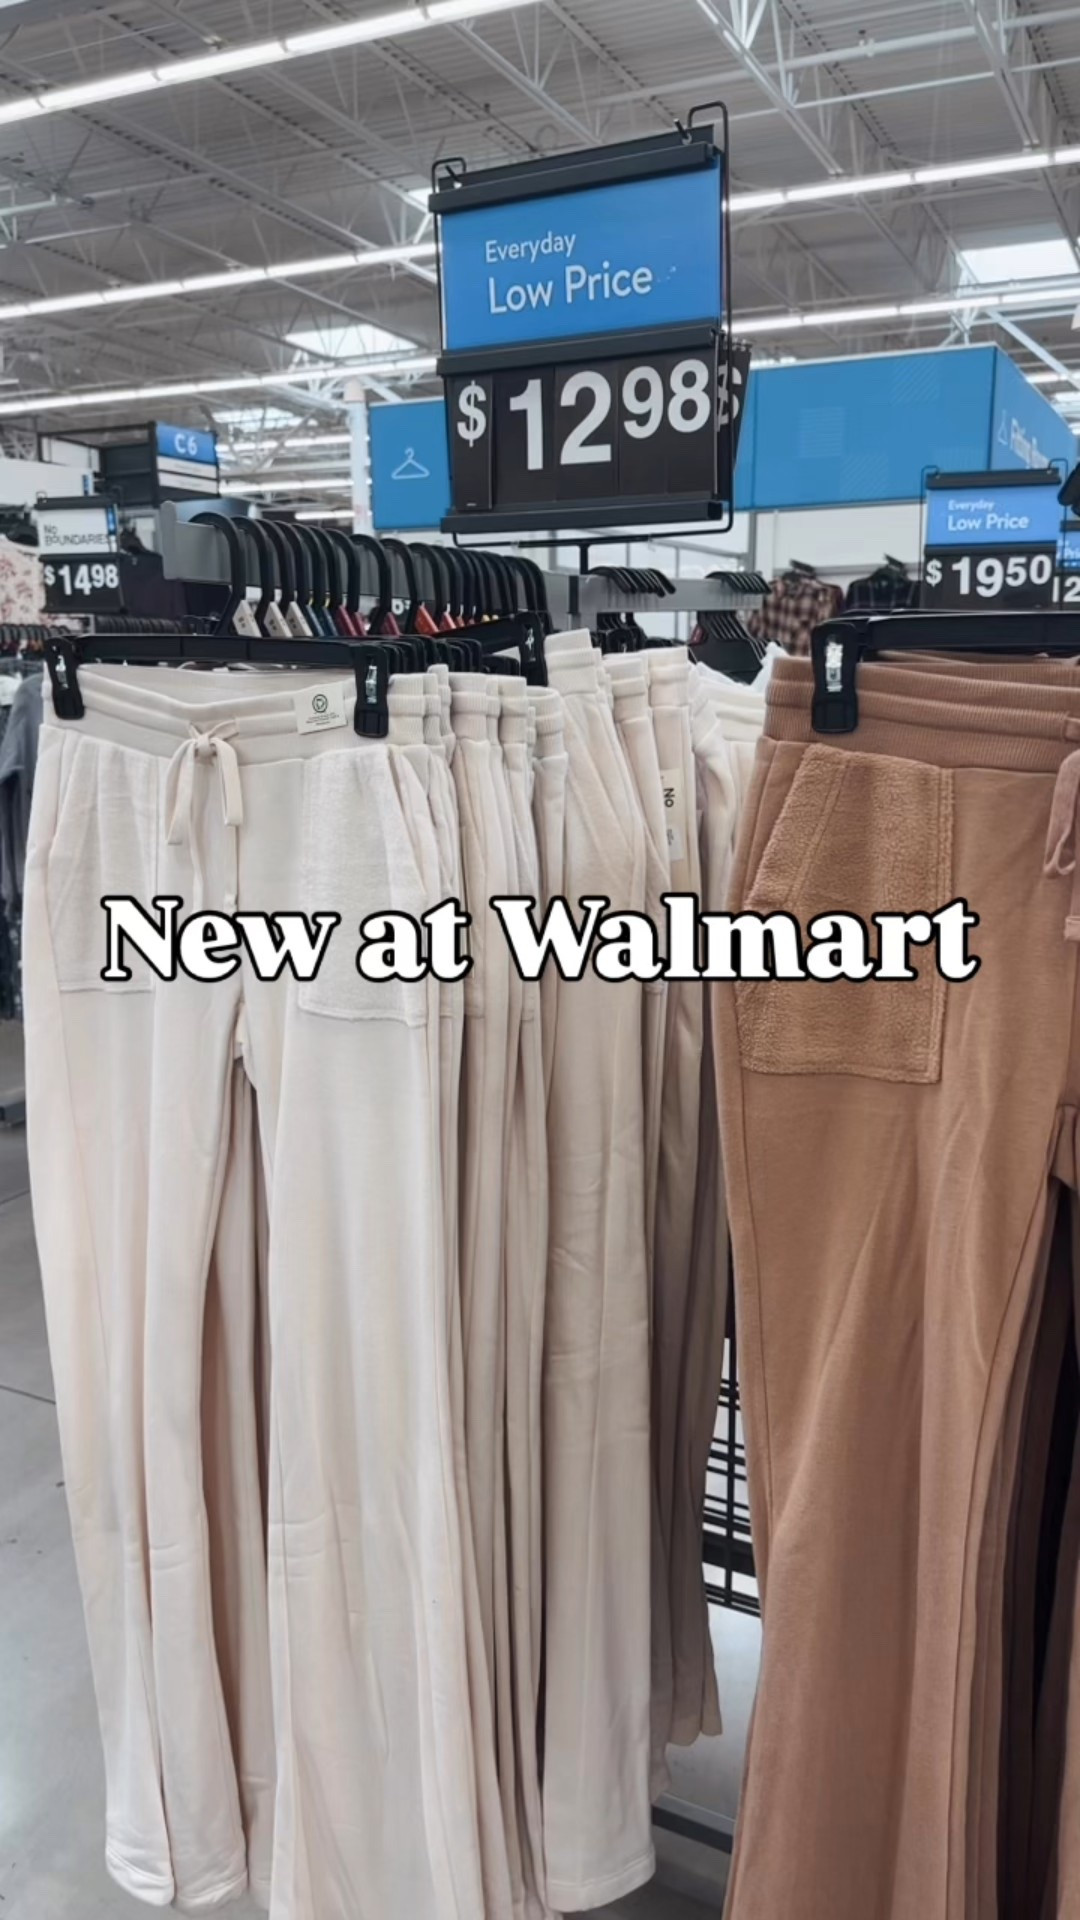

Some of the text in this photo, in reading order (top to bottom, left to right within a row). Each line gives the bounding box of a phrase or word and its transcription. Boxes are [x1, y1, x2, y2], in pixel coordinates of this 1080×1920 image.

[485, 230, 576, 263] Everyday
[488, 260, 653, 315] Low Price
[948, 499, 994, 512] Everyday
[947, 513, 1030, 531] Low Price
